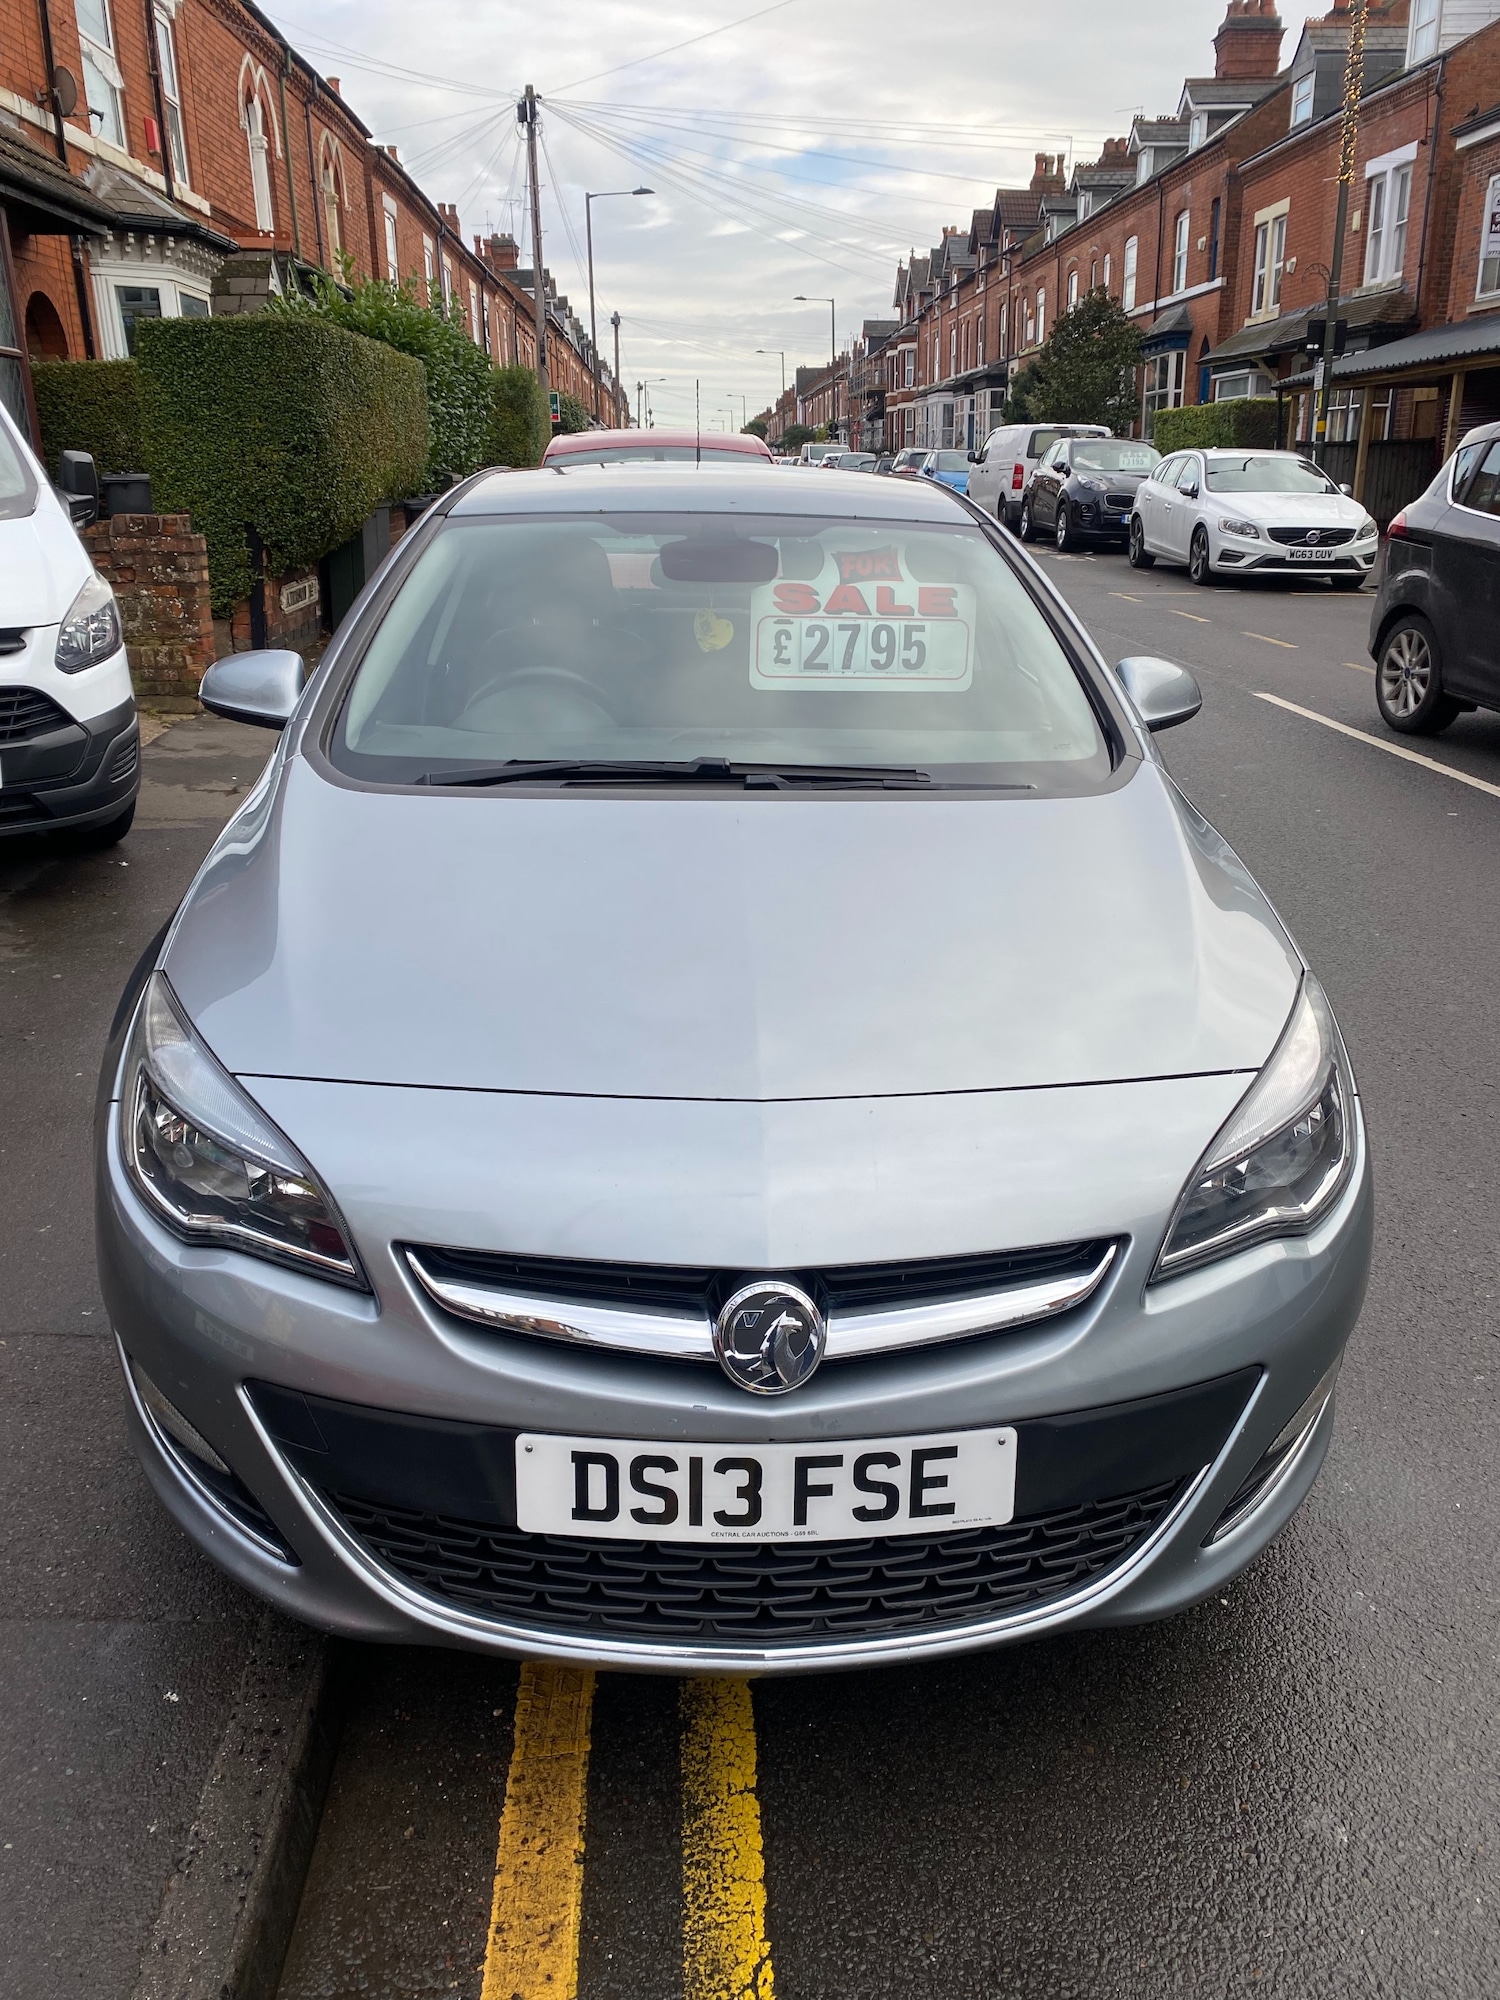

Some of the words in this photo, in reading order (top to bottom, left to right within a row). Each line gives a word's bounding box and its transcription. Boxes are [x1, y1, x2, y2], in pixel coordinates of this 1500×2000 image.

[772, 583, 958, 617] SALE
[773, 623, 927, 671] £2795
[571, 1450, 763, 1527] DS13
[793, 1445, 958, 1526] FSE
